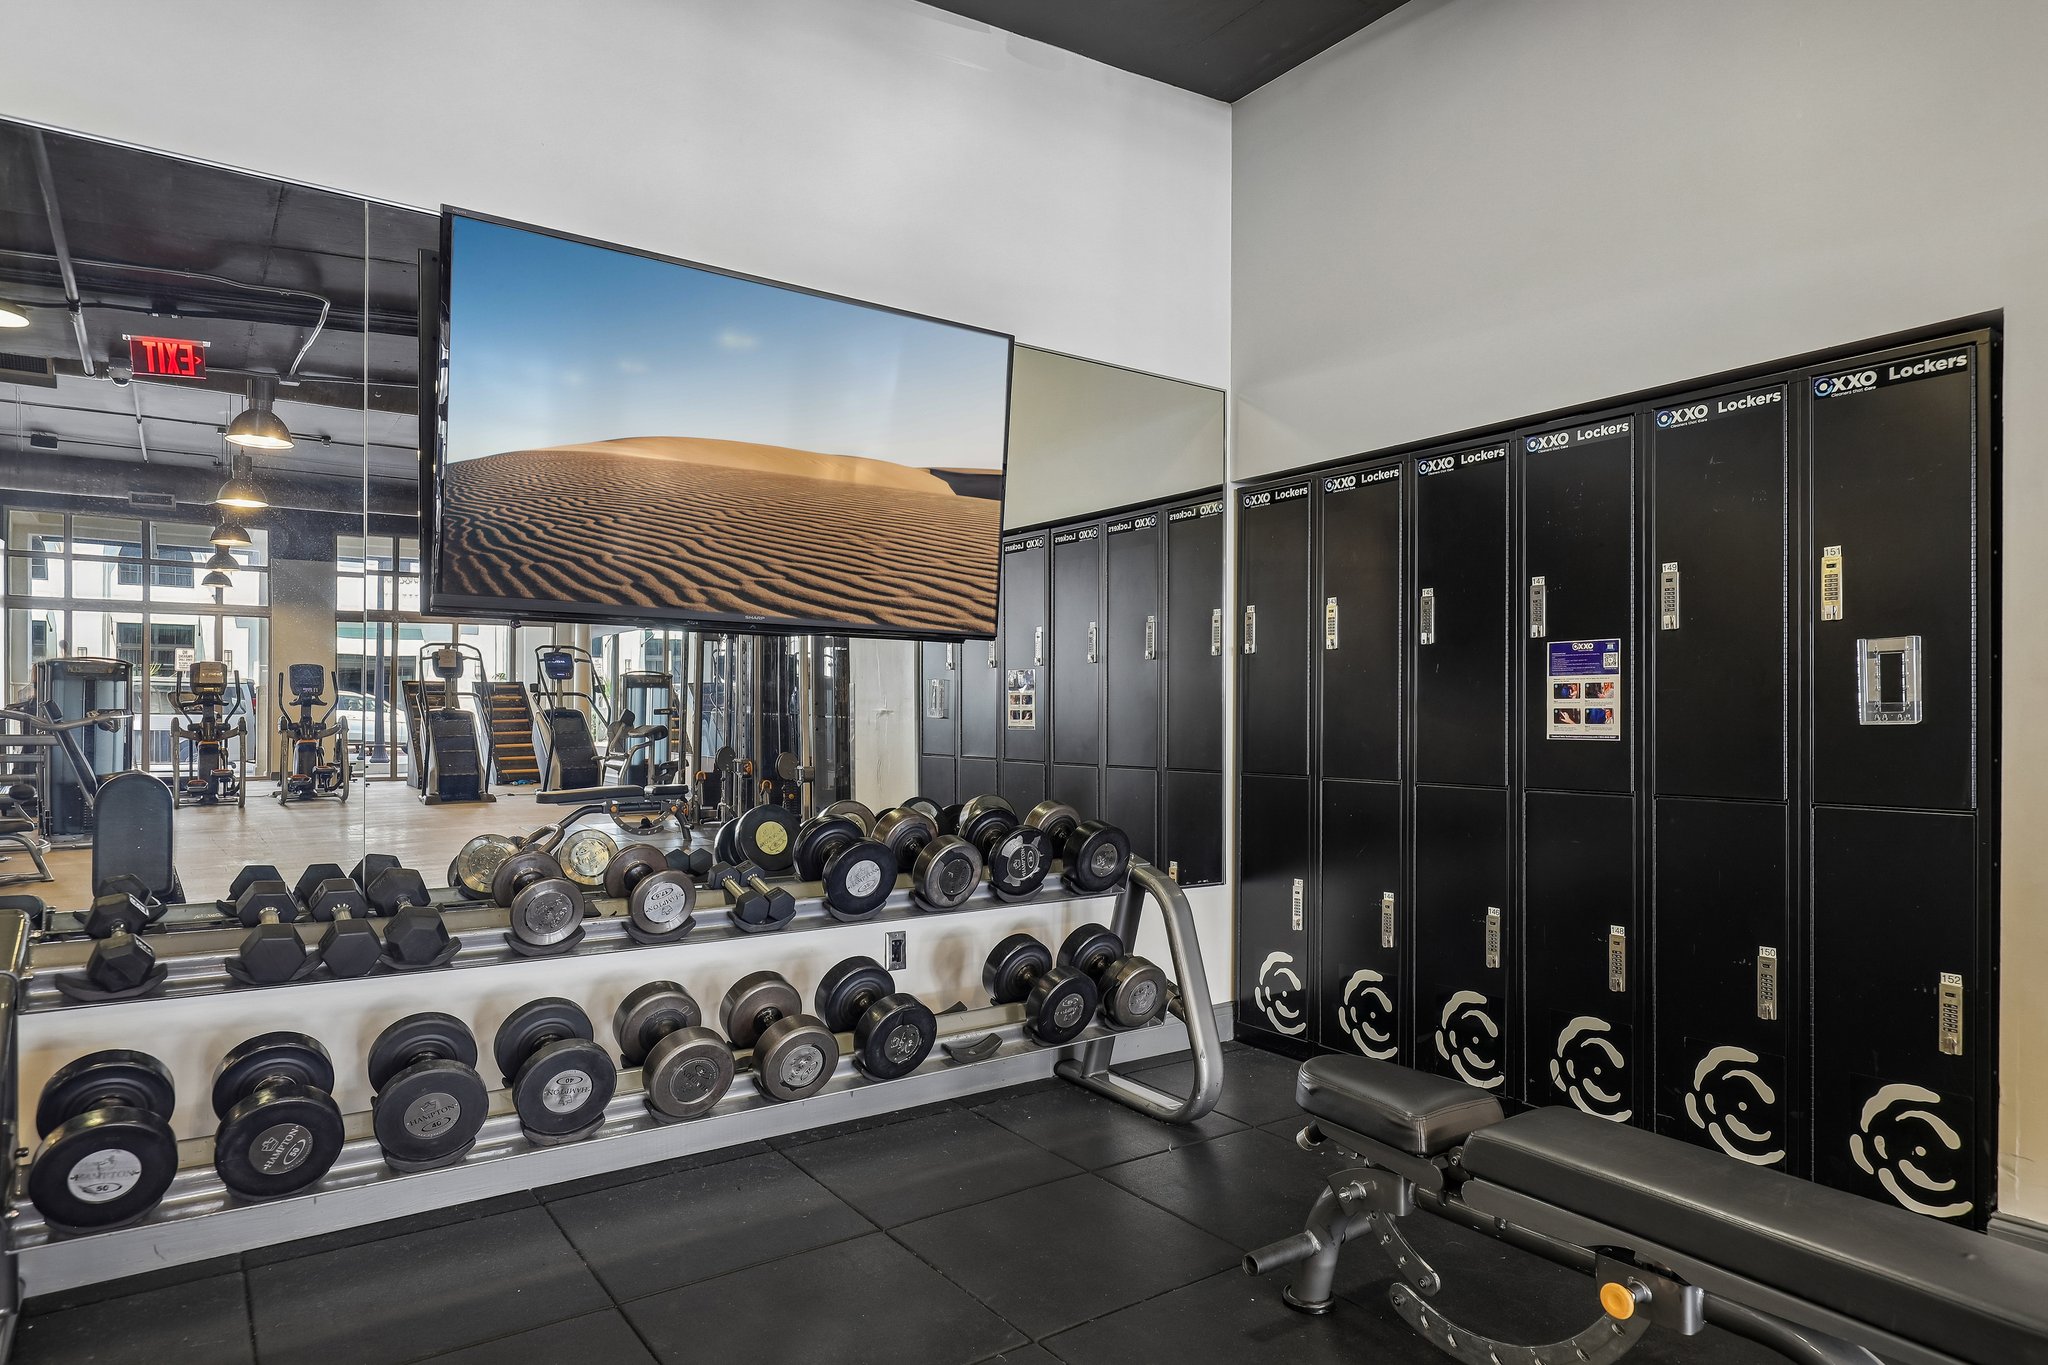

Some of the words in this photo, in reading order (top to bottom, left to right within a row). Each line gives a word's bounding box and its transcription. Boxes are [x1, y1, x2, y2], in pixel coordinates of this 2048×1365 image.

[1814, 370, 1877, 398] OXXO
[1889, 354, 1967, 380] Lockers
[1656, 404, 1708, 428] OXXO
[1718, 390, 1781, 414] Lockers
[1526, 432, 1569, 452] OXXO
[1577, 422, 1629, 441] Lockers
[1418, 456, 1454, 474] OXXO
[1461, 447, 1505, 465] Lockers
[1324, 475, 1356, 492] OXXO
[1361, 468, 1400, 484] Lockers
[1244, 492, 1270, 507] OXXO
[1275, 486, 1308, 500] Lockers
[1825, 548, 1840, 556] 151
[1664, 564, 1677, 572] 149
[1611, 927, 1624, 935] 148
[1760, 948, 1776, 957] 150
[1942, 975, 1961, 985] 152
[547, 1087, 588, 1096] HAMPTON
[410, 1104, 454, 1126] HAMPTON
[264, 1128, 299, 1168] HAMPTON
[289, 1147, 300, 1157] 50
